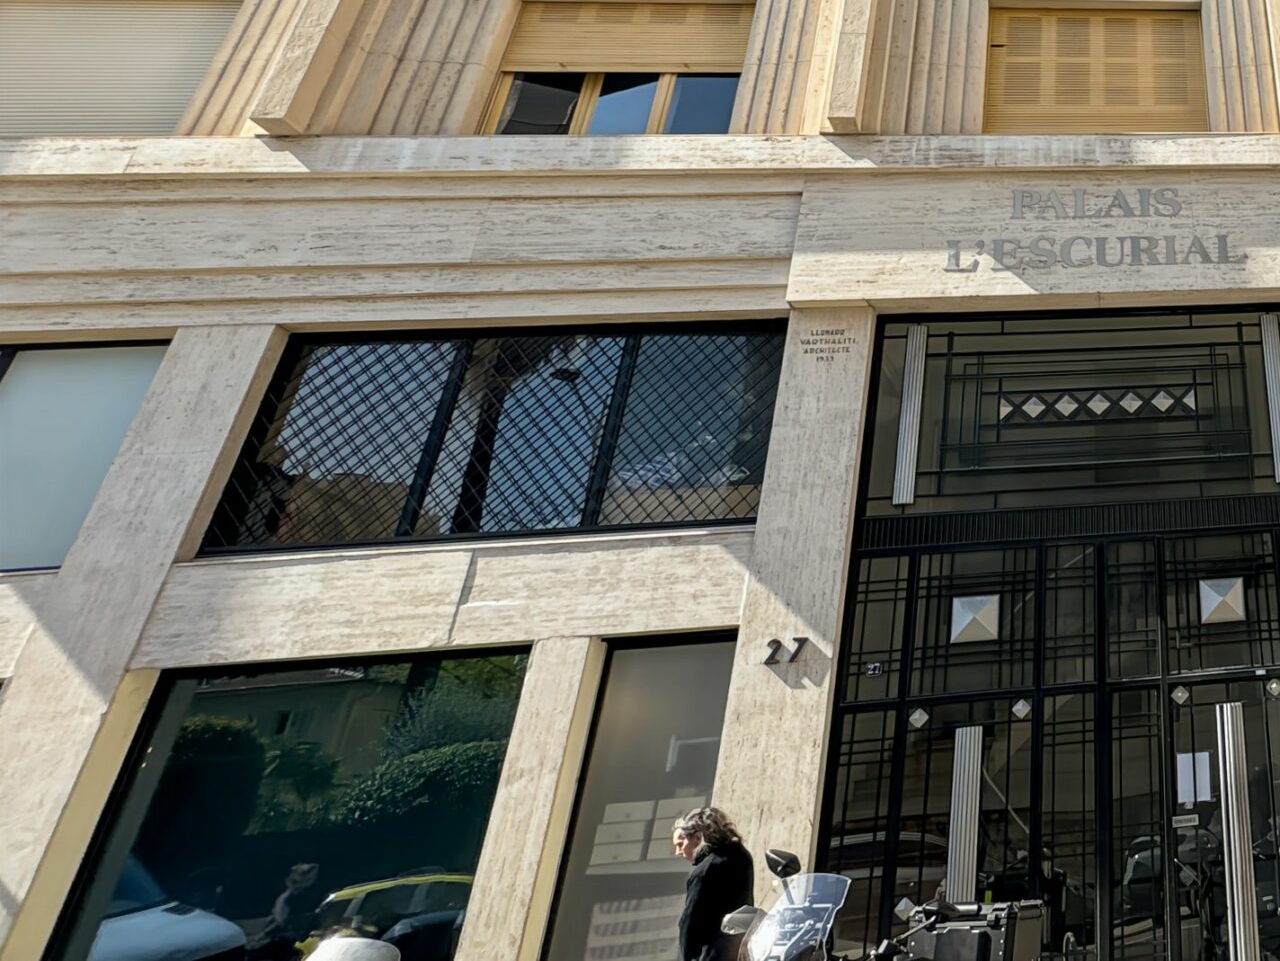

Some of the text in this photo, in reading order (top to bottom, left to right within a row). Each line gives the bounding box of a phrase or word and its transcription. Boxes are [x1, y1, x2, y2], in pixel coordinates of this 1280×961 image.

[1010, 188, 1183, 220] PALAIS
[943, 234, 1249, 272] L'ESCURIAL
[763, 637, 809, 665] 27
[867, 662, 880, 675] 27
